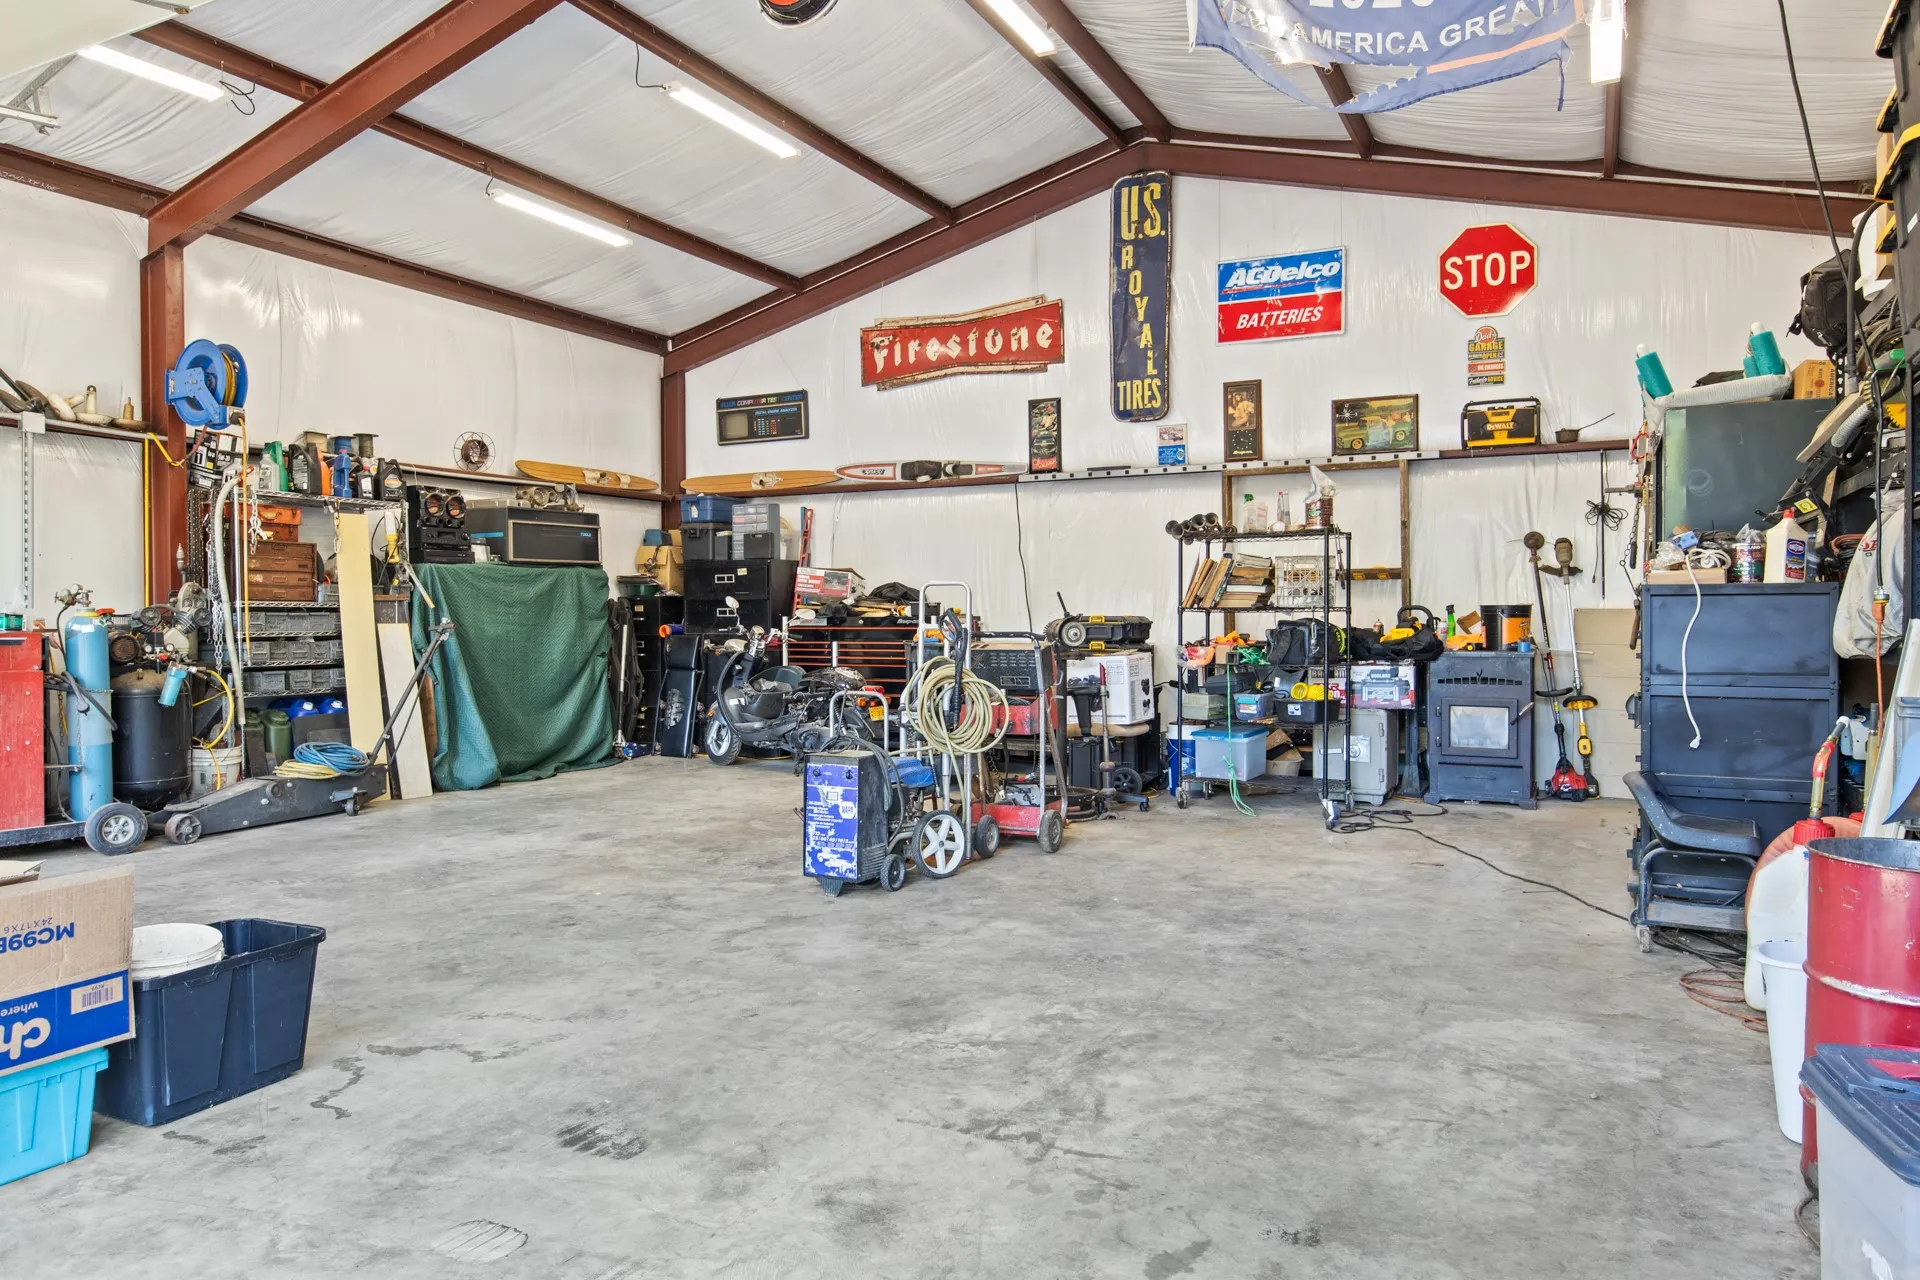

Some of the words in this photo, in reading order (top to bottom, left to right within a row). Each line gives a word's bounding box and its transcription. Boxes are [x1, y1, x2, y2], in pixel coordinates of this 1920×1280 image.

[1292, 21, 1430, 55] AMERICA
[1120, 182, 1166, 241] U.S.
[1225, 260, 1341, 289] ACDelco
[1443, 250, 1532, 291] STOP
[1121, 245, 1158, 376] ROYAL
[1236, 305, 1324, 330] BATTERIES
[869, 322, 1054, 375] Firestone
[1469, 341, 1504, 352] GARAGE
[1117, 378, 1162, 411] TIRES
[42, 917, 53, 925] 24
[0, 1001, 39, 1017] where
